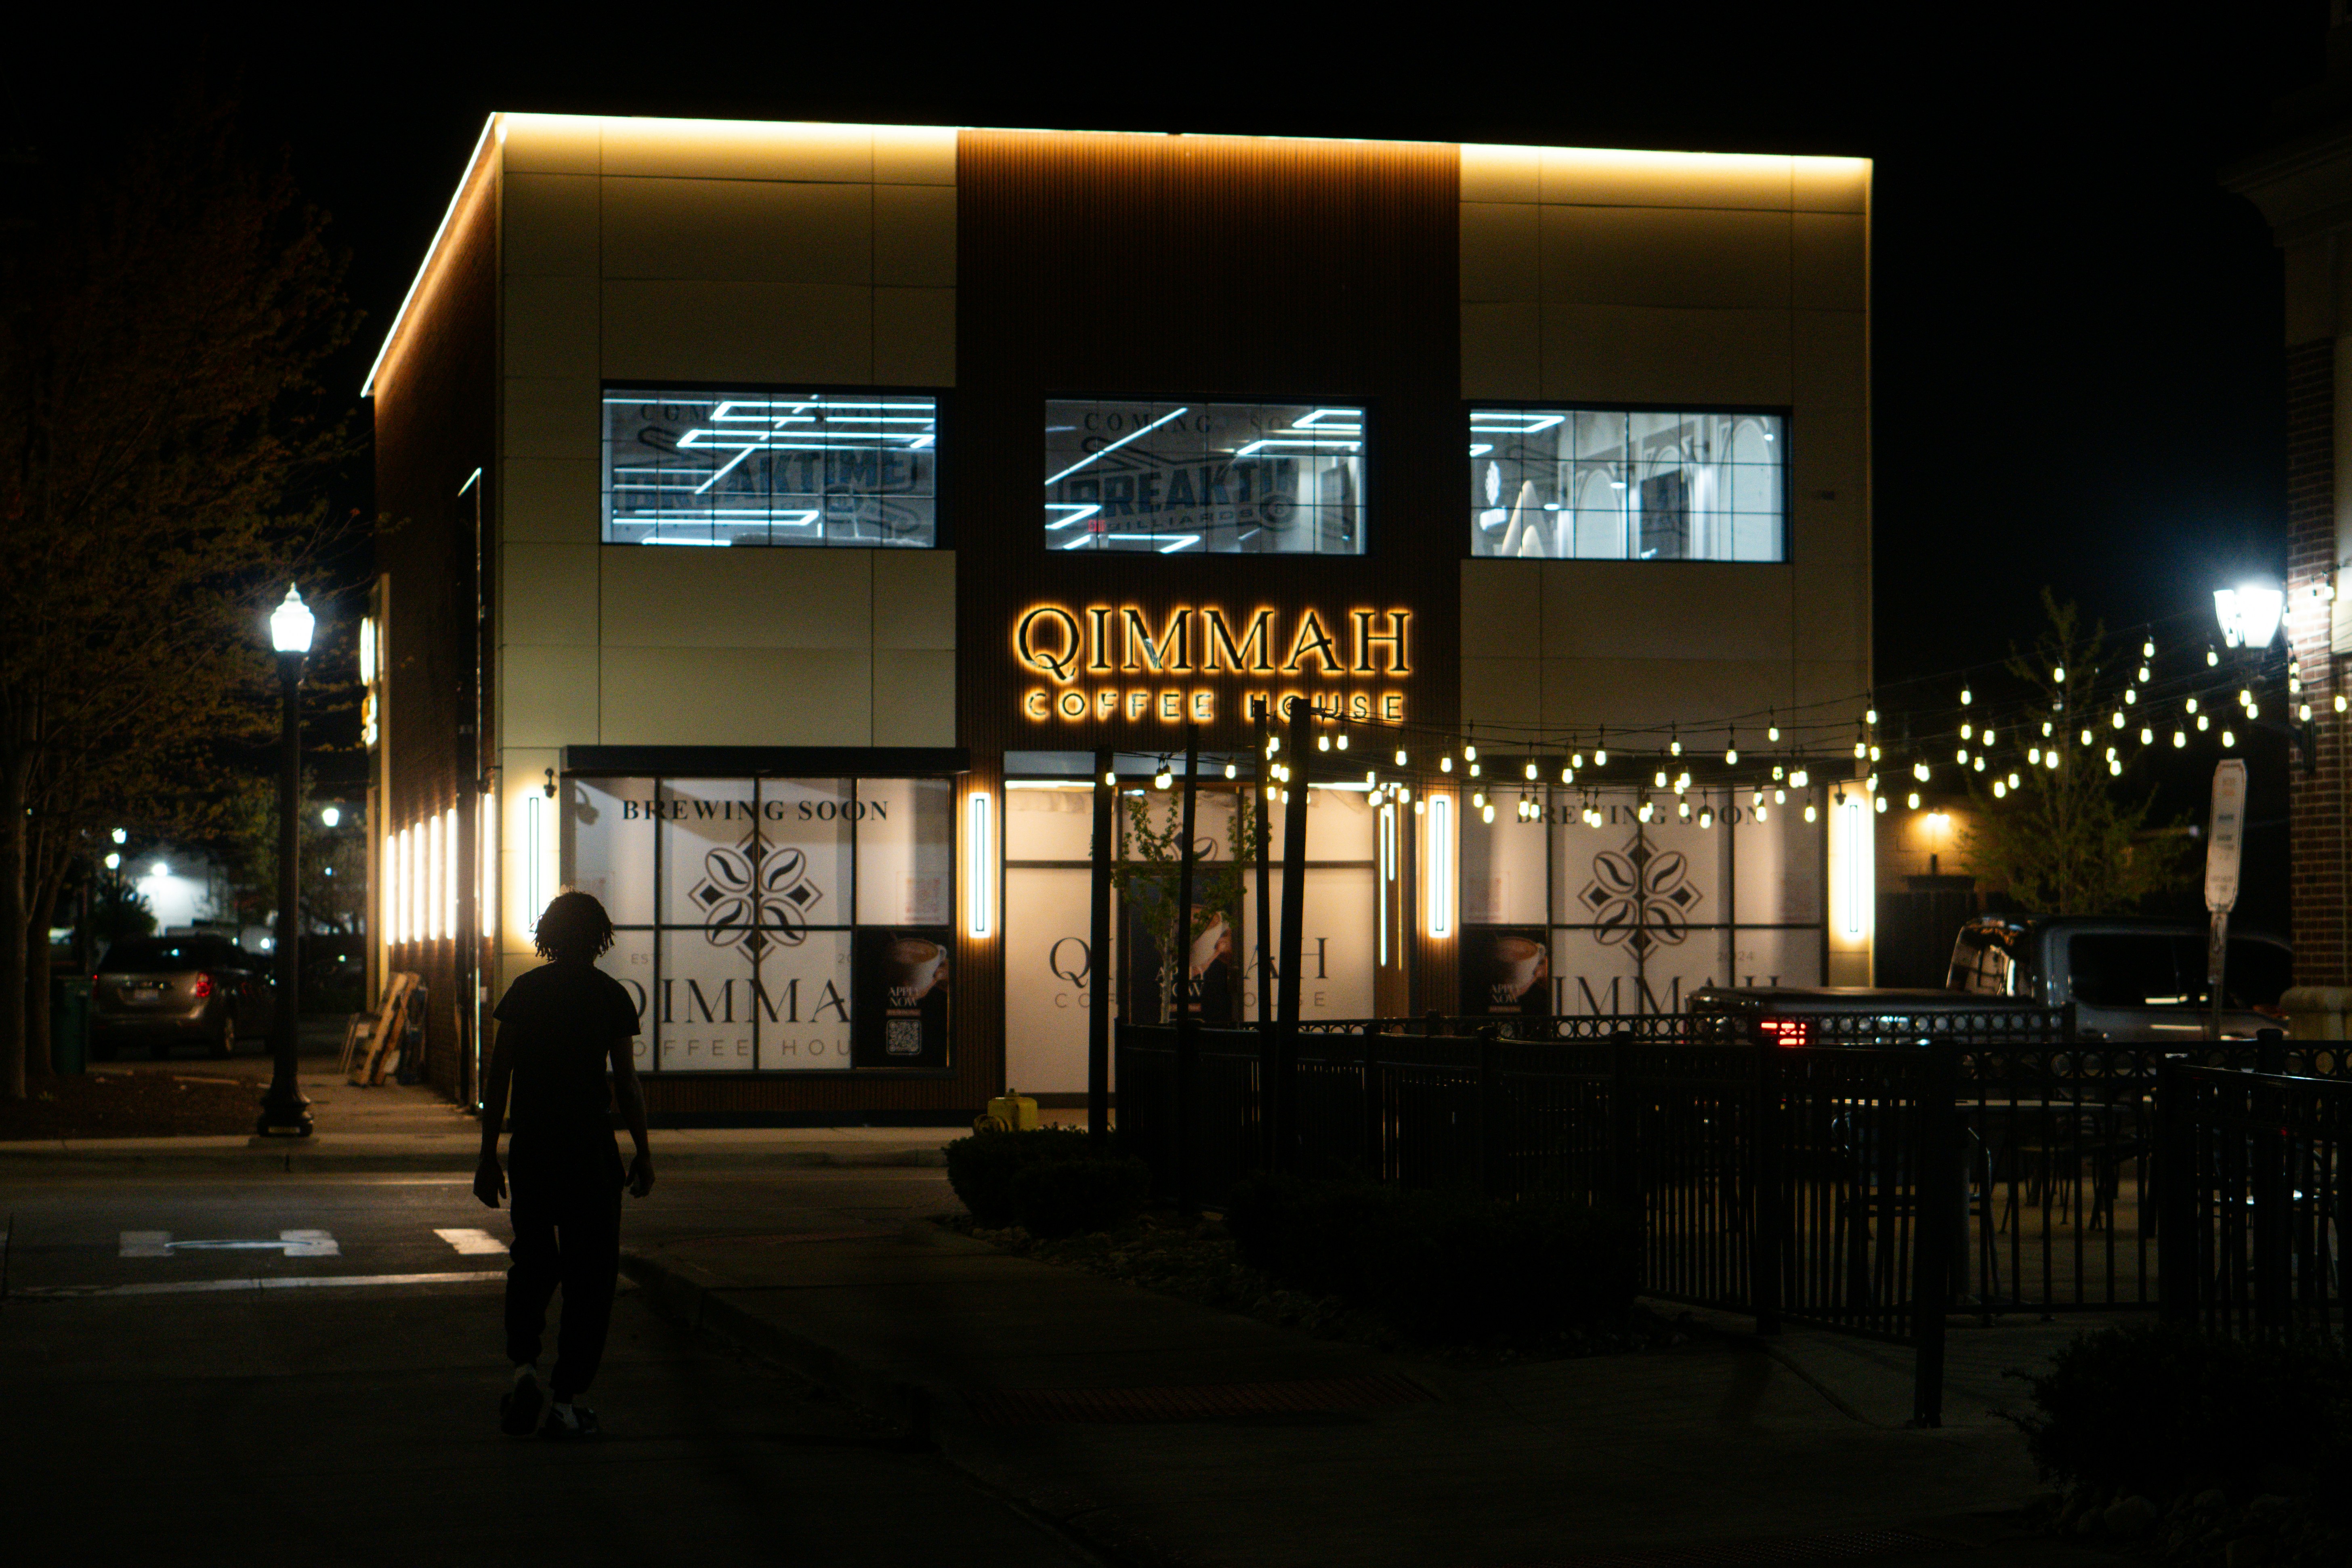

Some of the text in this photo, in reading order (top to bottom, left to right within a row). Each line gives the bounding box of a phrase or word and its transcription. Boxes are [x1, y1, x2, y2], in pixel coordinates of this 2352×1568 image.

[1018, 607, 1410, 681] QIMMAH
[1027, 692, 1213, 718] COFFEE
[623, 800, 889, 821] BREWING SOON
[1718, 951, 1754, 962] 224
[890, 997, 918, 1007] NOW
[633, 1039, 851, 1057] OFFEE HOU
